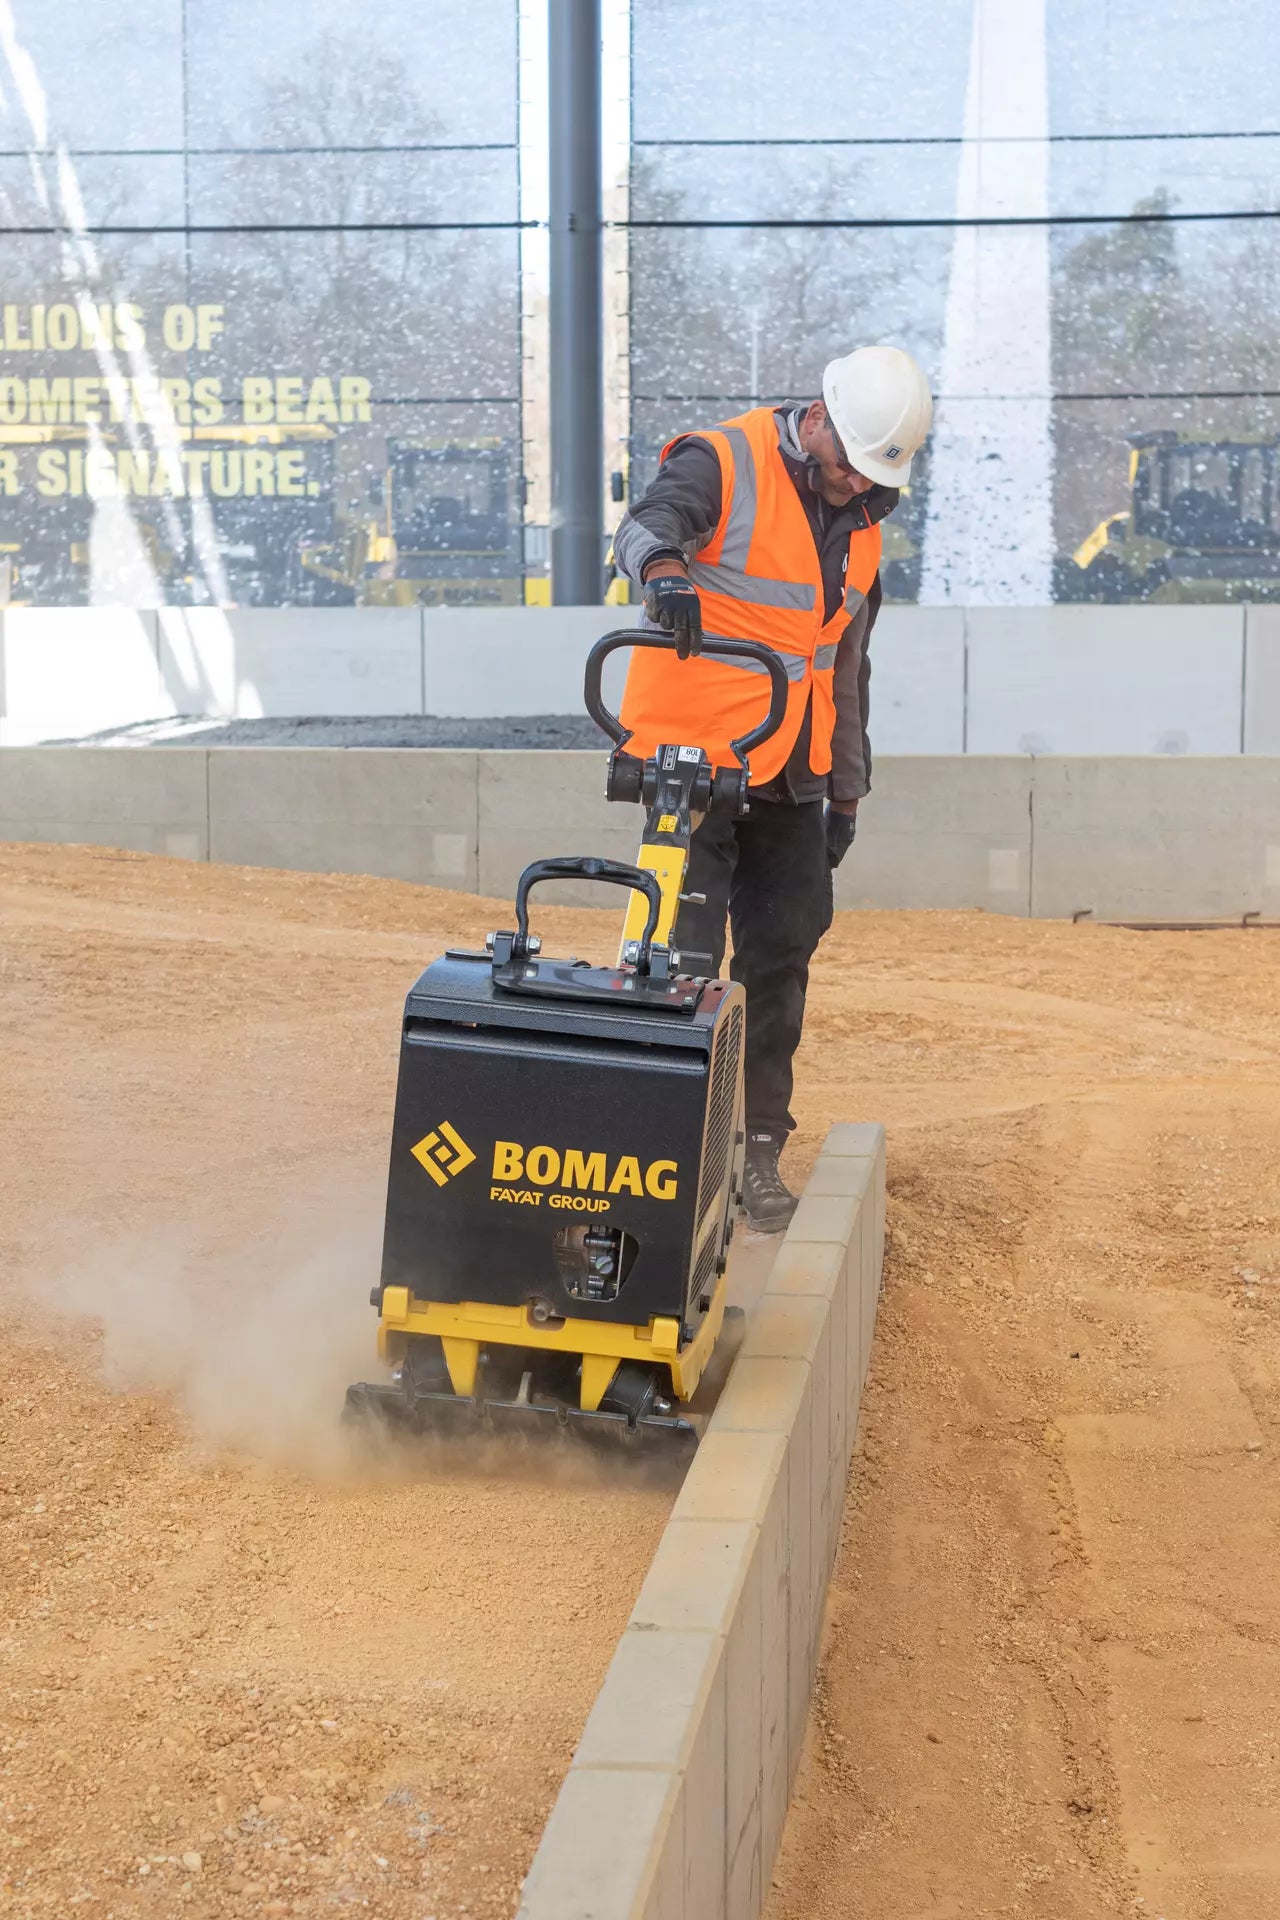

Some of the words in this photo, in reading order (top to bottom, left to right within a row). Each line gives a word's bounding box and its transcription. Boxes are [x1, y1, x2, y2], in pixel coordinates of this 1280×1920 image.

[0, 304, 146, 351] LIONS
[163, 304, 225, 351] OF
[0, 376, 224, 424] OMETRS
[243, 376, 372, 424] BEAR
[37, 450, 320, 497] SIGNATURE.
[491, 1140, 678, 1200] BOMAG
[490, 1187, 543, 1206] FAYAT
[548, 1194, 611, 1213] GROUP
